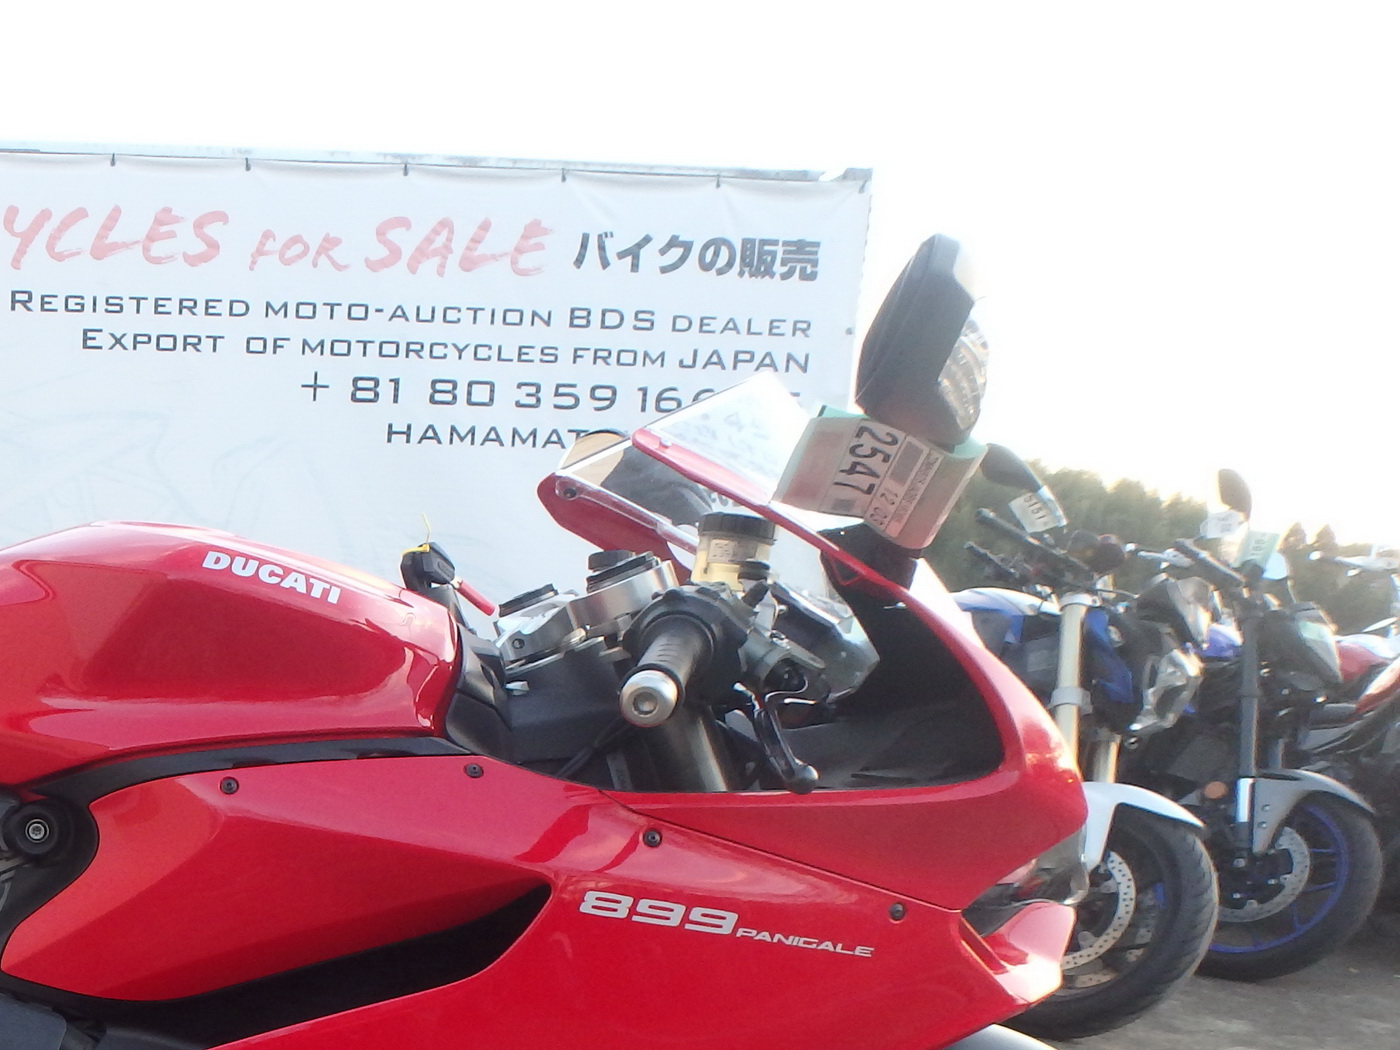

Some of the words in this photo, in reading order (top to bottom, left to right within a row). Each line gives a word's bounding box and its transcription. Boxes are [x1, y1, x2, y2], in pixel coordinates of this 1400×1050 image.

[364, 216, 555, 278] SALE
[572, 231, 821, 283] バイクの販売
[568, 306, 656, 332] BDS
[670, 314, 812, 338] DEALER
[245, 335, 291, 355] OF
[301, 337, 559, 363] MOTORCYCLES
[571, 346, 666, 368] FROM
[677, 348, 811, 374] JAPAN
[350, 375, 401, 405] 81
[428, 378, 496, 407] 80
[514, 381, 618, 412] 359
[386, 422, 589, 450] HAMAMAT
[833, 424, 899, 496] 2547
[202, 551, 341, 604] DUCATI
[578, 890, 739, 936] 899
[735, 926, 875, 958] PANIGALE
